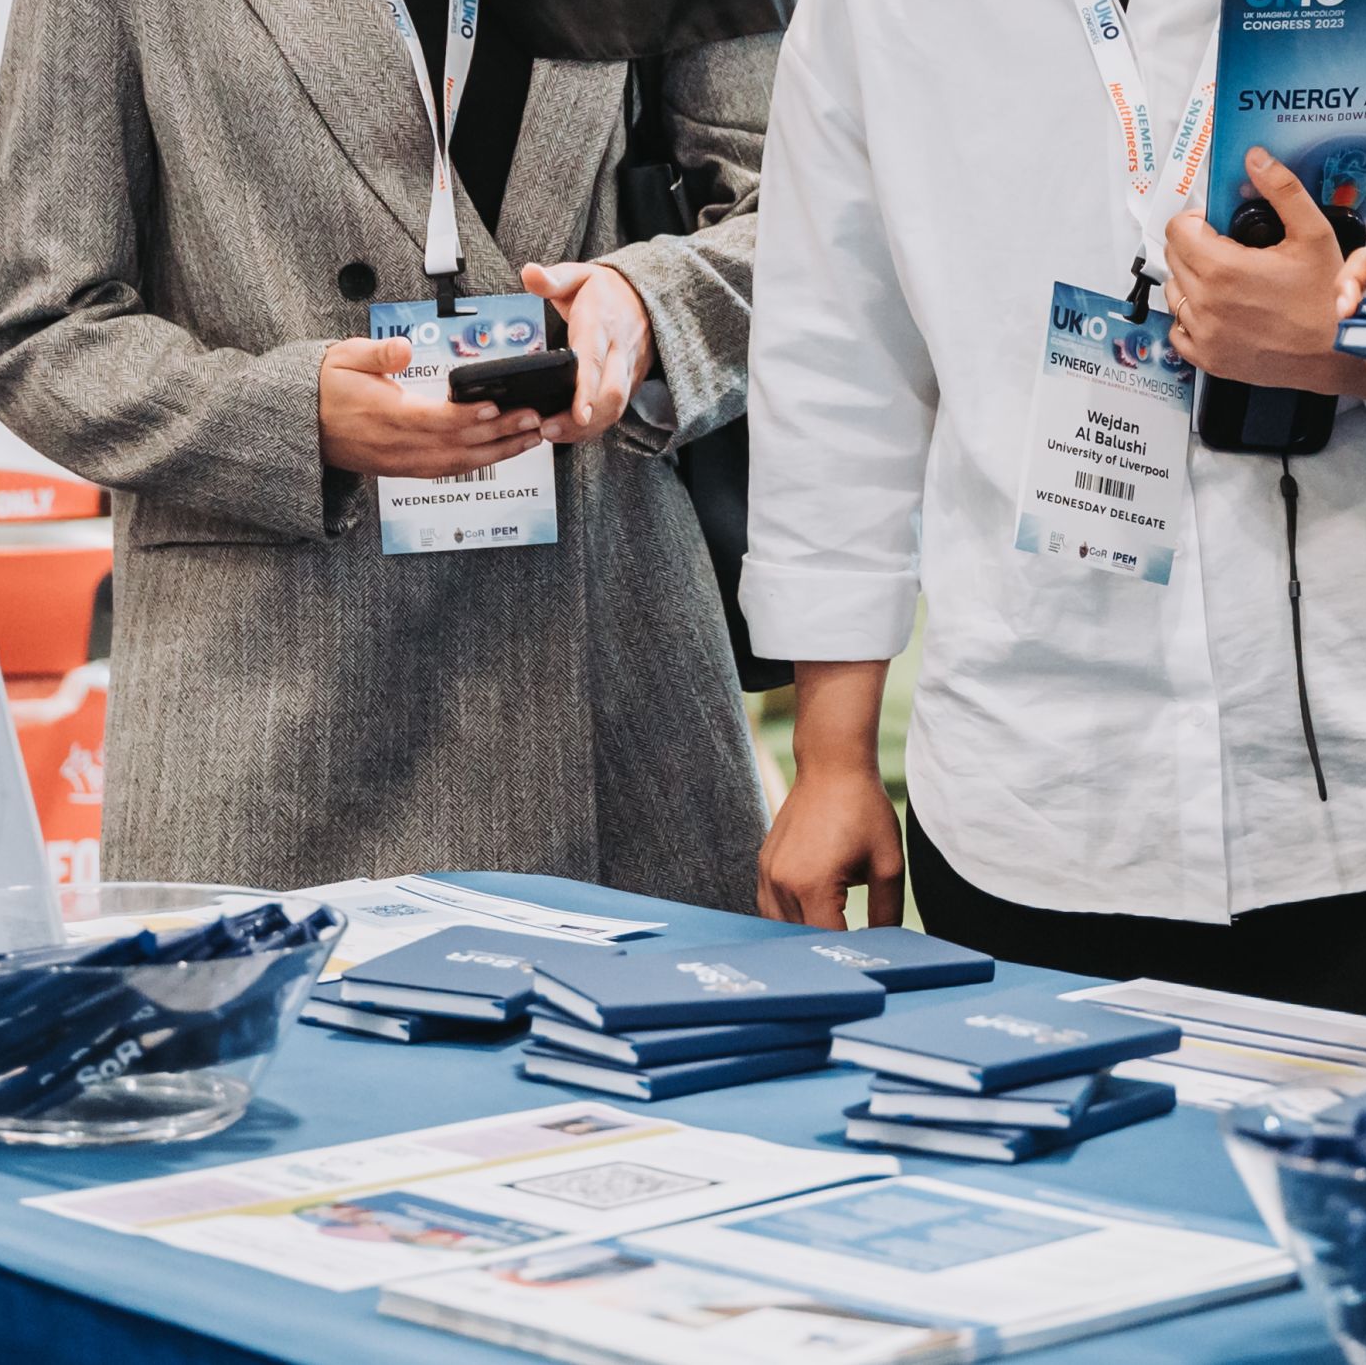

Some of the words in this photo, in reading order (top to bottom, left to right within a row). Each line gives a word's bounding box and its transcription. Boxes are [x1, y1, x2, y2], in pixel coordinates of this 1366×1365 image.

[1242, 20, 1311, 31] CONGRESS
[1315, 18, 1344, 29] 2023
[1256, 11, 1291, 19] IMAGING
[1301, 10, 1346, 18] ONCOLOGY
[1238, 87, 1360, 111] SYNERGY
[1109, 82, 1138, 173] Healthineers
[1172, 98, 1203, 162] SIEMENS
[1277, 113, 1334, 123] BREAKING
[1135, 104, 1155, 172] SIEMENS
[1050, 352, 1101, 377] SYNERGY
[1103, 367, 1127, 384] AND
[1087, 410, 1140, 434] Wejdan
[1075, 426, 1090, 442] Al
[1095, 431, 1147, 455] Balushi
[1047, 438, 1103, 464] University
[1105, 455, 1117, 466] of
[1119, 457, 1169, 479] Liverpool
[392, 493, 471, 507] WEDNESDAY
[476, 487, 539, 501] DELEGATE
[1036, 490, 1107, 514] WEDNESDAY
[1110, 508, 1166, 530] DELEGATE
[491, 526, 518, 536] IPEM
[1089, 546, 1108, 559] CoR
[1112, 551, 1137, 565] IPEM
[76, 1039, 143, 1084] SoR
